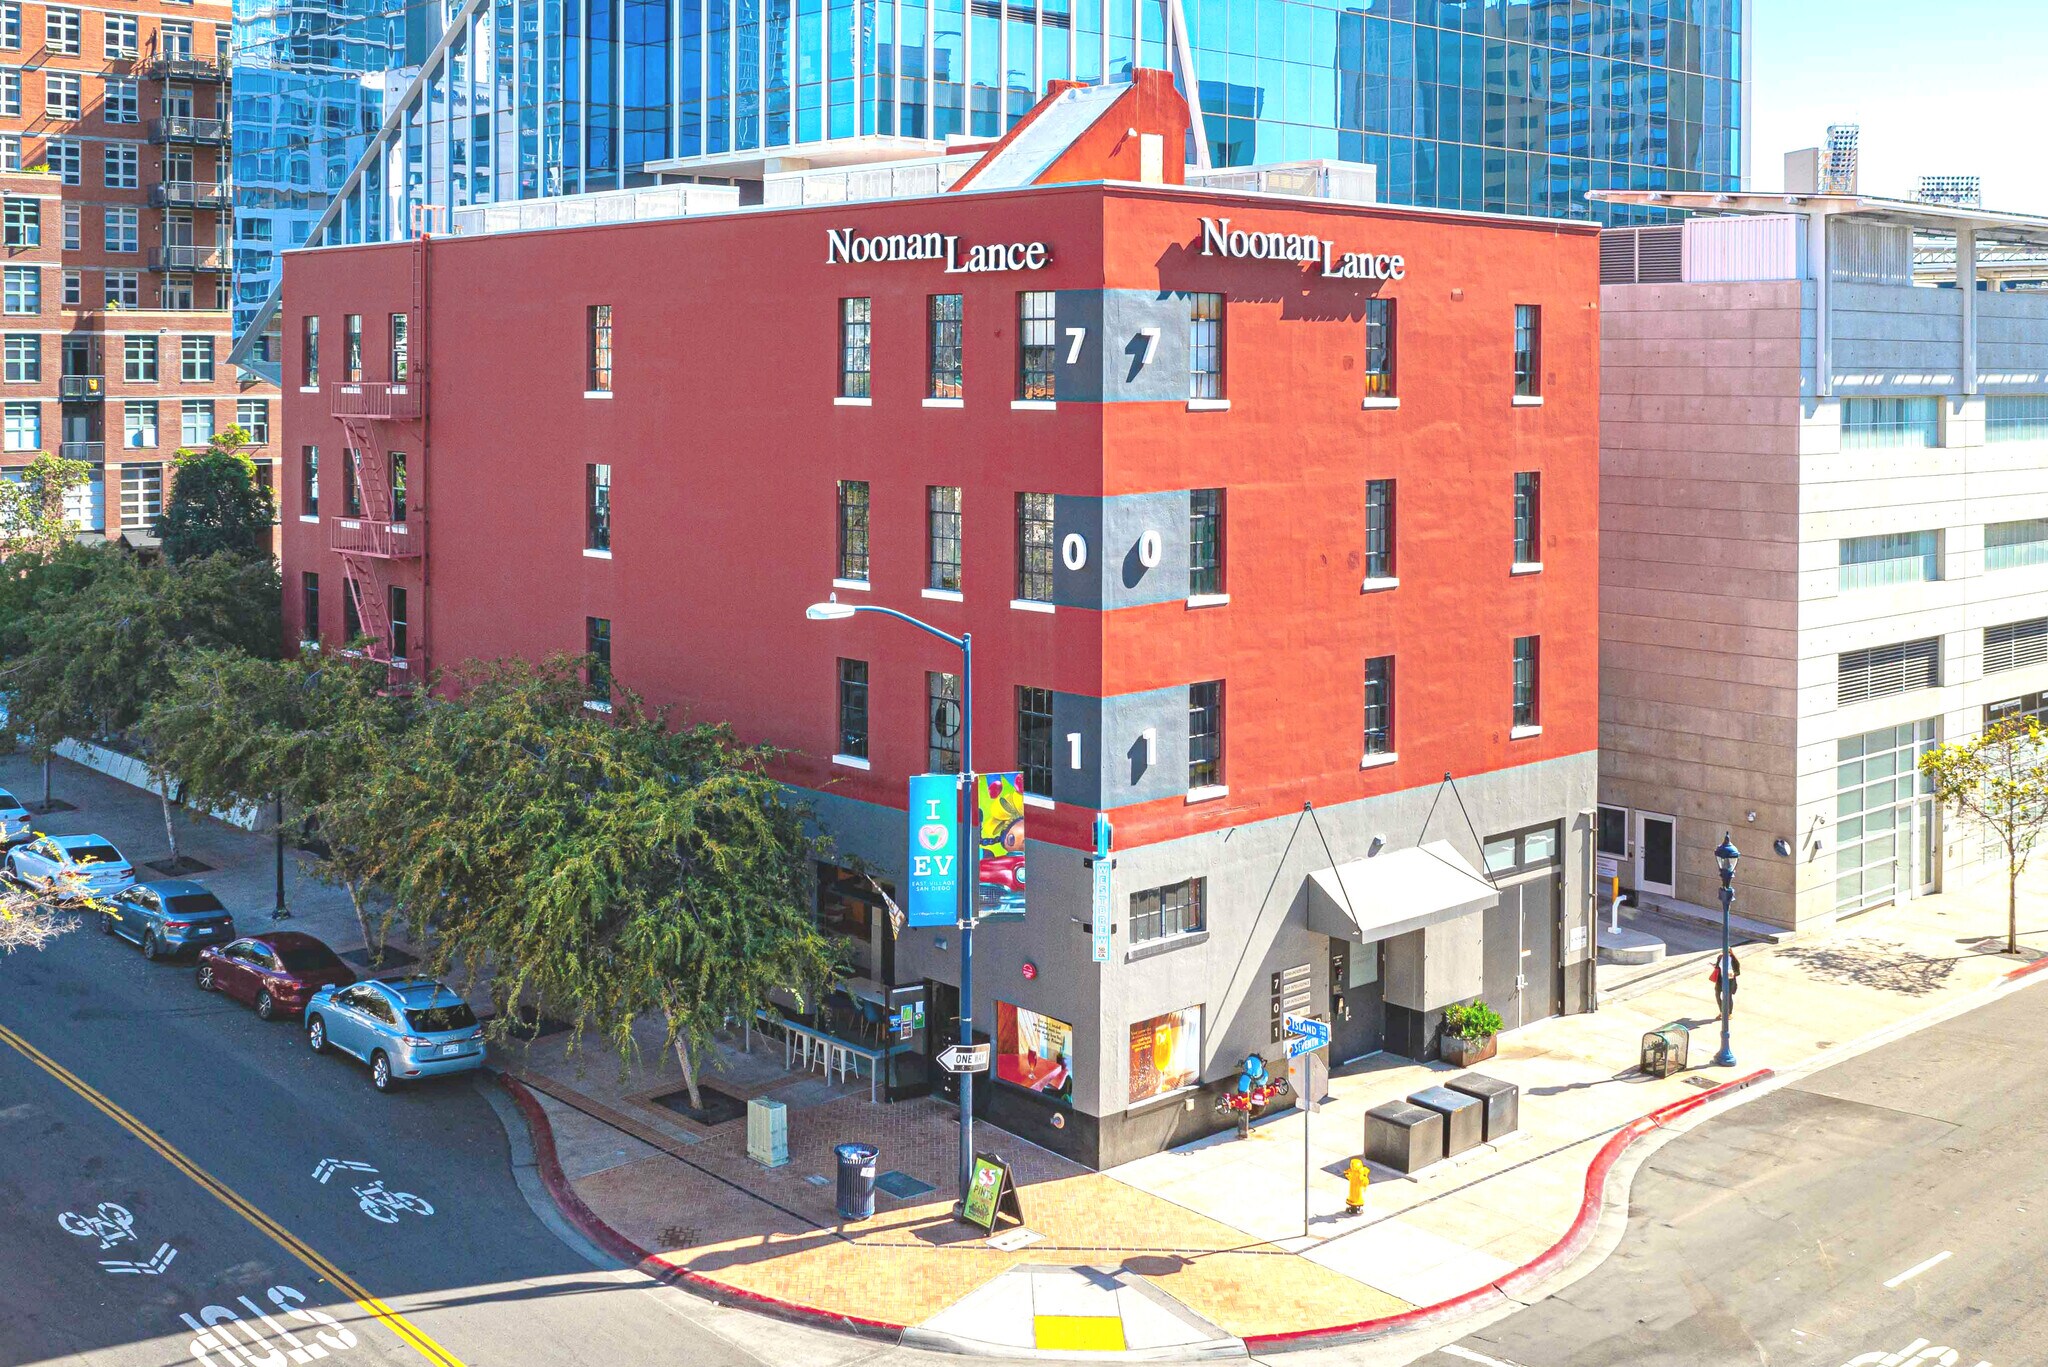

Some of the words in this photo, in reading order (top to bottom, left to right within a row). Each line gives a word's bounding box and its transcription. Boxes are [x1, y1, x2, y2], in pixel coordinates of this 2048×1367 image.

[1066, 328, 1086, 364] 7
[1141, 328, 1161, 364] 7
[1067, 733, 1082, 770] 1
[1142, 728, 1157, 766] 1
[926, 799, 941, 820] I
[913, 855, 954, 876] EV
[1292, 1021, 1317, 1035] ISLAND
[956, 1055, 972, 1063] ONE
[974, 1054, 984, 1062] WAY
[979, 1168, 996, 1186] $5
[973, 1185, 993, 1201] PINTS
